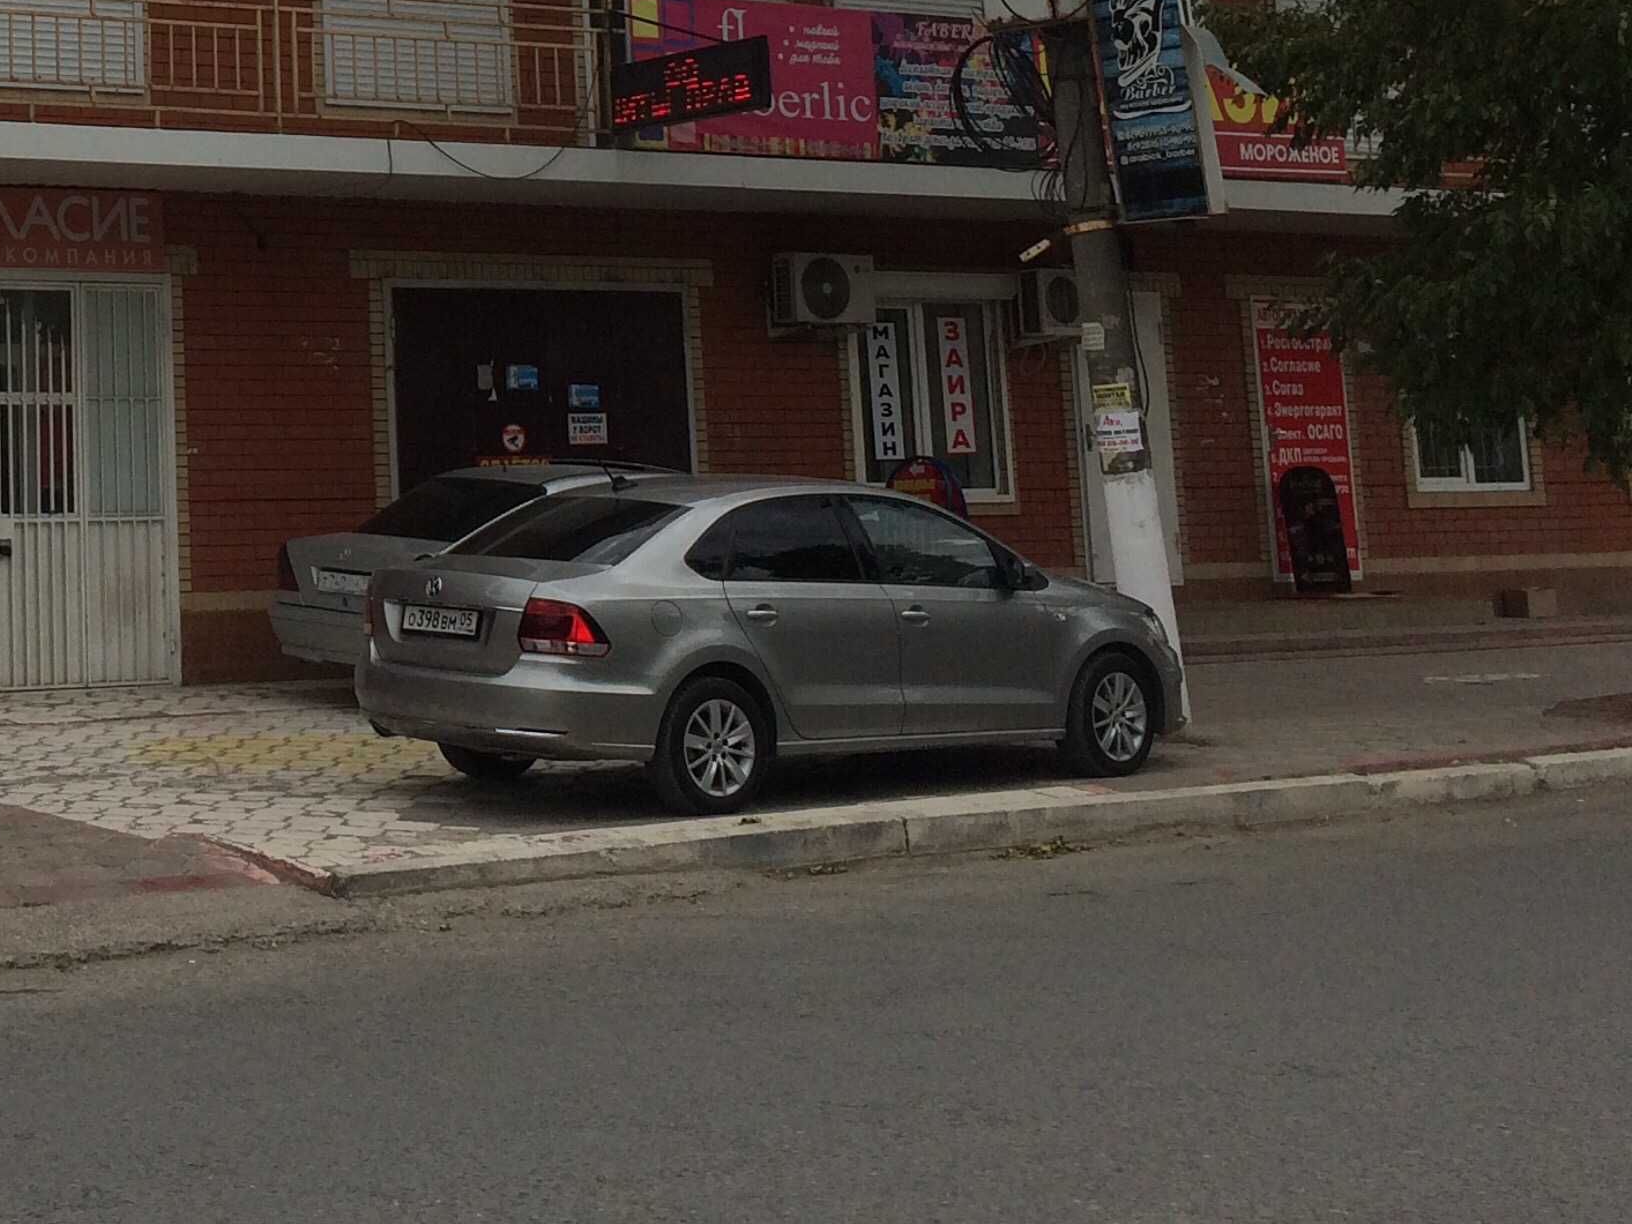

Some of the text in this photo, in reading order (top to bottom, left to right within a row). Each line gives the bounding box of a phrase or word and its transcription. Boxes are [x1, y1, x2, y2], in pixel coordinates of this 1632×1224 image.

[1239, 143, 1340, 164] МОРОЖЕНОЕ
[5, 246, 152, 266] КОМПАНИЯ
[872, 326, 897, 456] МАГАЗИН
[944, 321, 971, 449] ЗАИРА
[1308, 424, 1343, 440] ОСАГО
